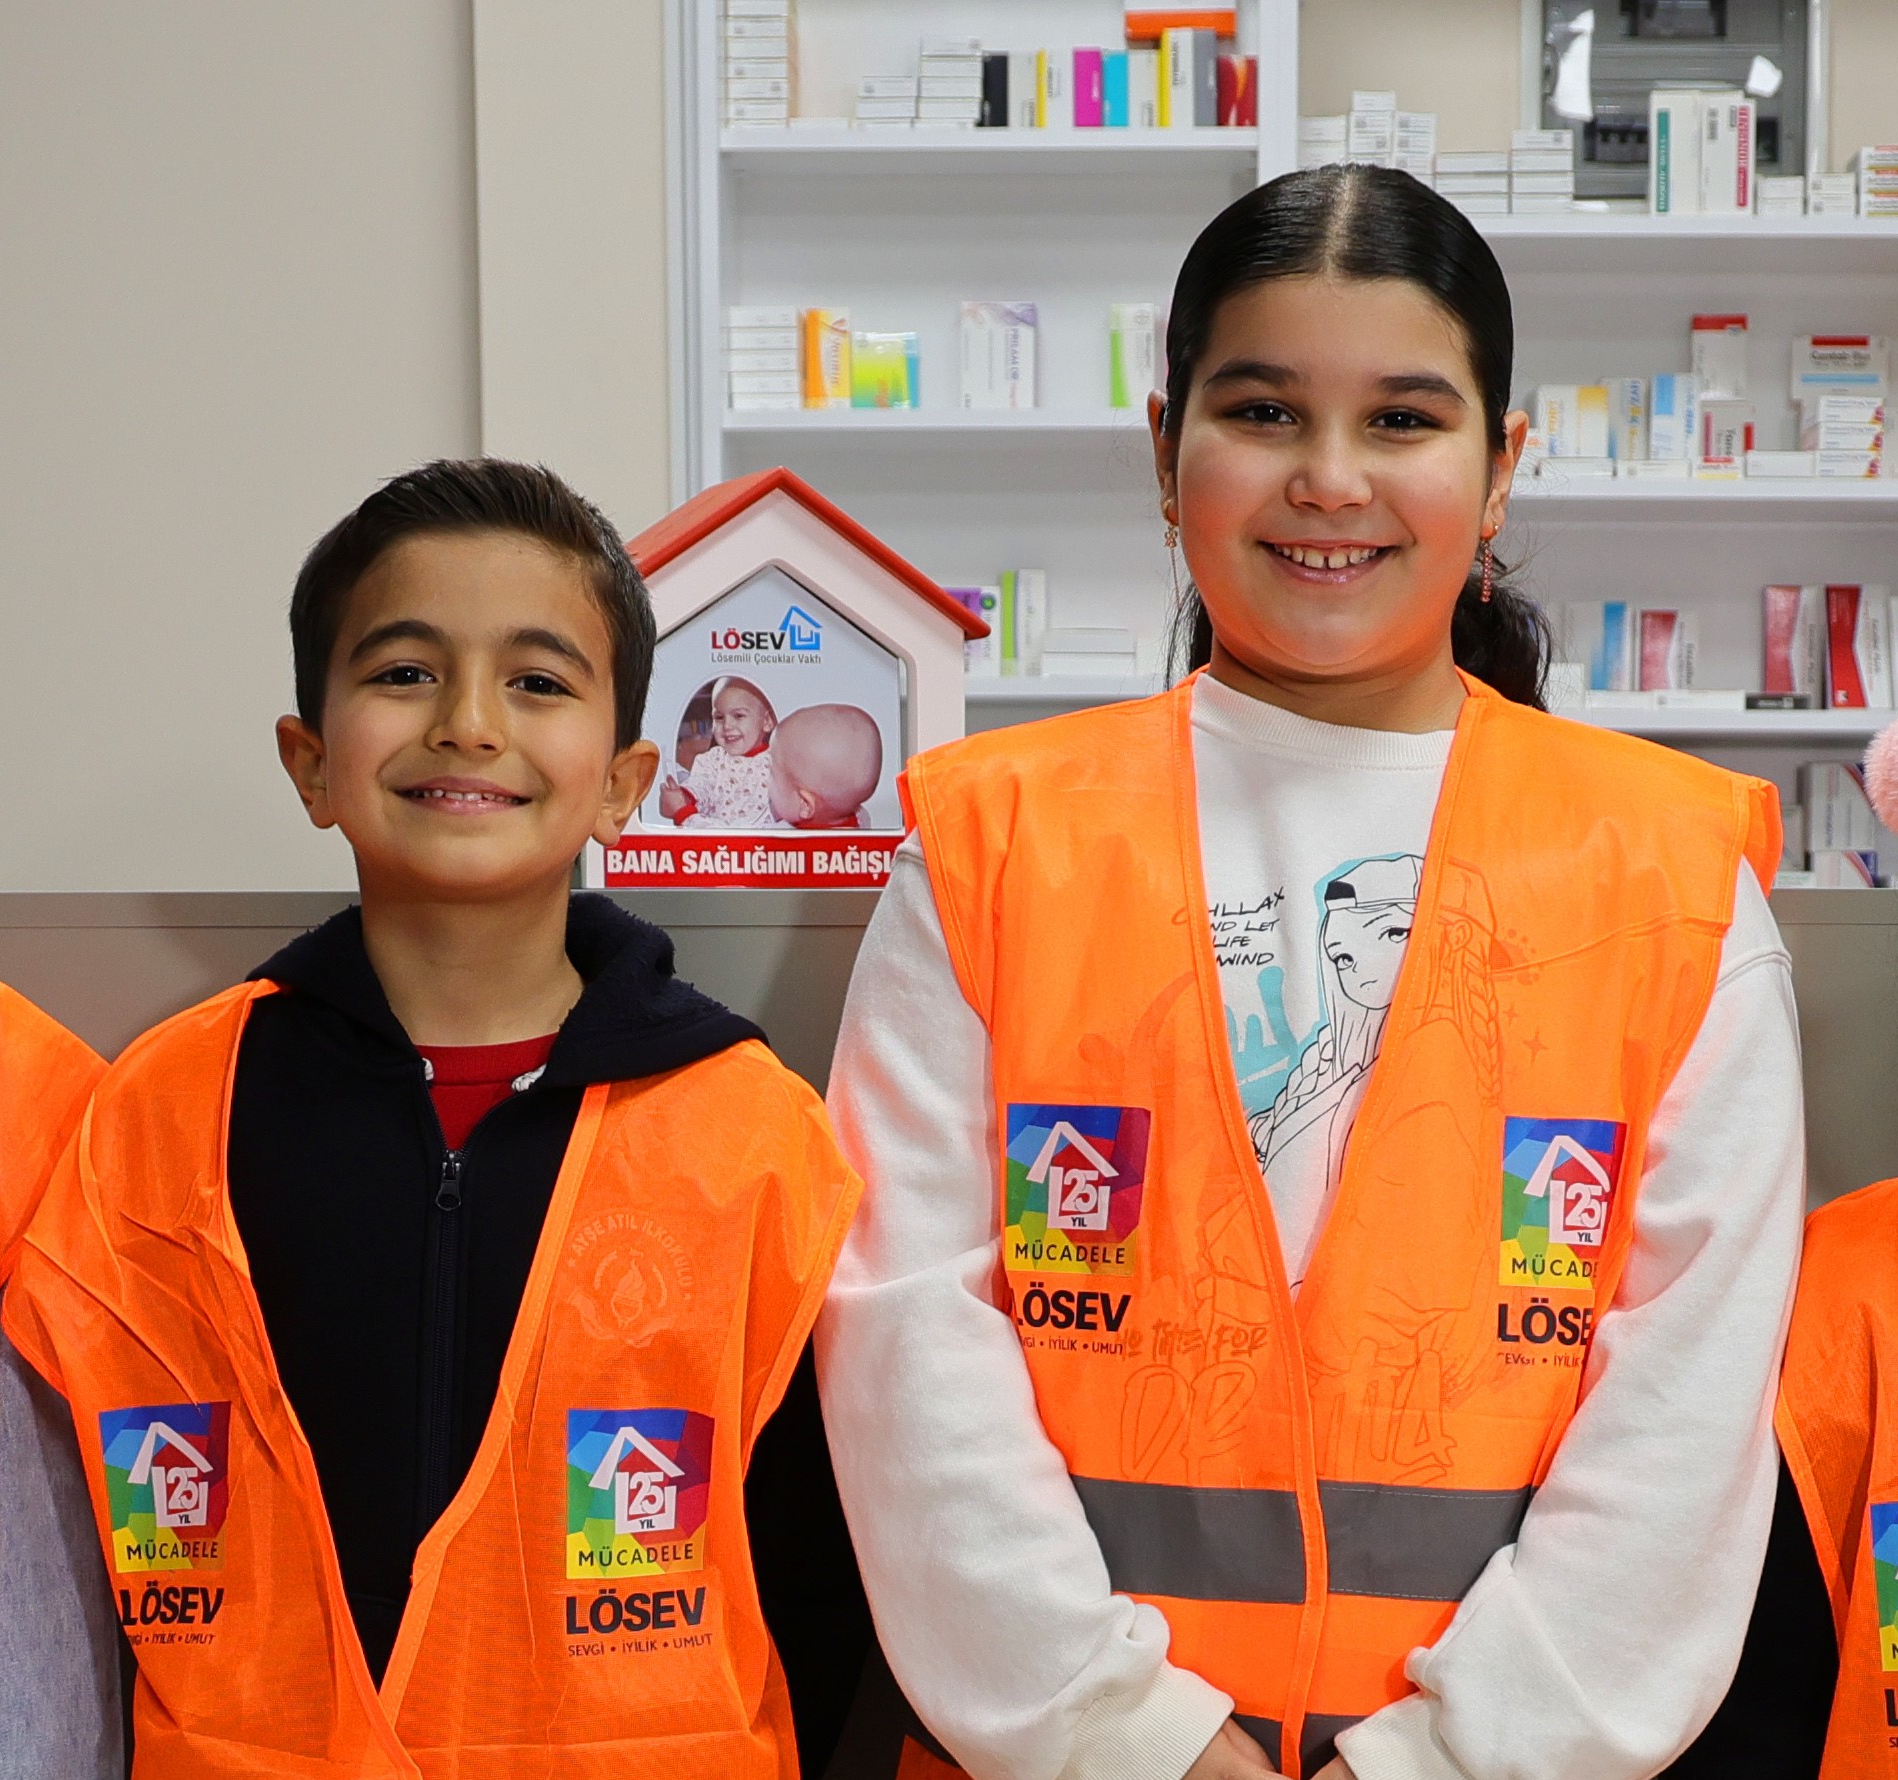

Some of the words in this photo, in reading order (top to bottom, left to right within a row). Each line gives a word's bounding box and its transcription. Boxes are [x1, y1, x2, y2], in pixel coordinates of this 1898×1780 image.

[711, 628, 785, 650] LÖSEV
[711, 653, 751, 664] Lösemili
[754, 653, 795, 666] Çocuklar
[607, 850, 675, 874] BANA
[682, 845, 805, 875] SAĞLIĞIMI
[812, 845, 894, 880] BAĞIŞL
[1244, 917, 1281, 932] LET
[1061, 1168, 1098, 1213] 25
[1566, 1182, 1602, 1228] 25
[1071, 1217, 1087, 1227] YIL
[1577, 1232, 1593, 1243] YIL
[1015, 1240, 1125, 1264] MÜCADELE
[1512, 1254, 1598, 1278] MÜCAD
[1015, 1282, 1131, 1332] ÖSEV
[1497, 1298, 1595, 1346] LÖSE
[167, 1467, 198, 1510] 25
[629, 1471, 663, 1515] 25
[178, 1514, 191, 1524] YIL
[639, 1519, 655, 1529] YIL
[127, 1539, 218, 1561] MÜCADELE
[579, 1544, 693, 1567] MÜCADELE
[119, 1581, 224, 1626] LÖSEV
[566, 1587, 706, 1634] LÖSEV
[568, 1644, 604, 1657] SEVGİ
[674, 1633, 713, 1649] UMUT
